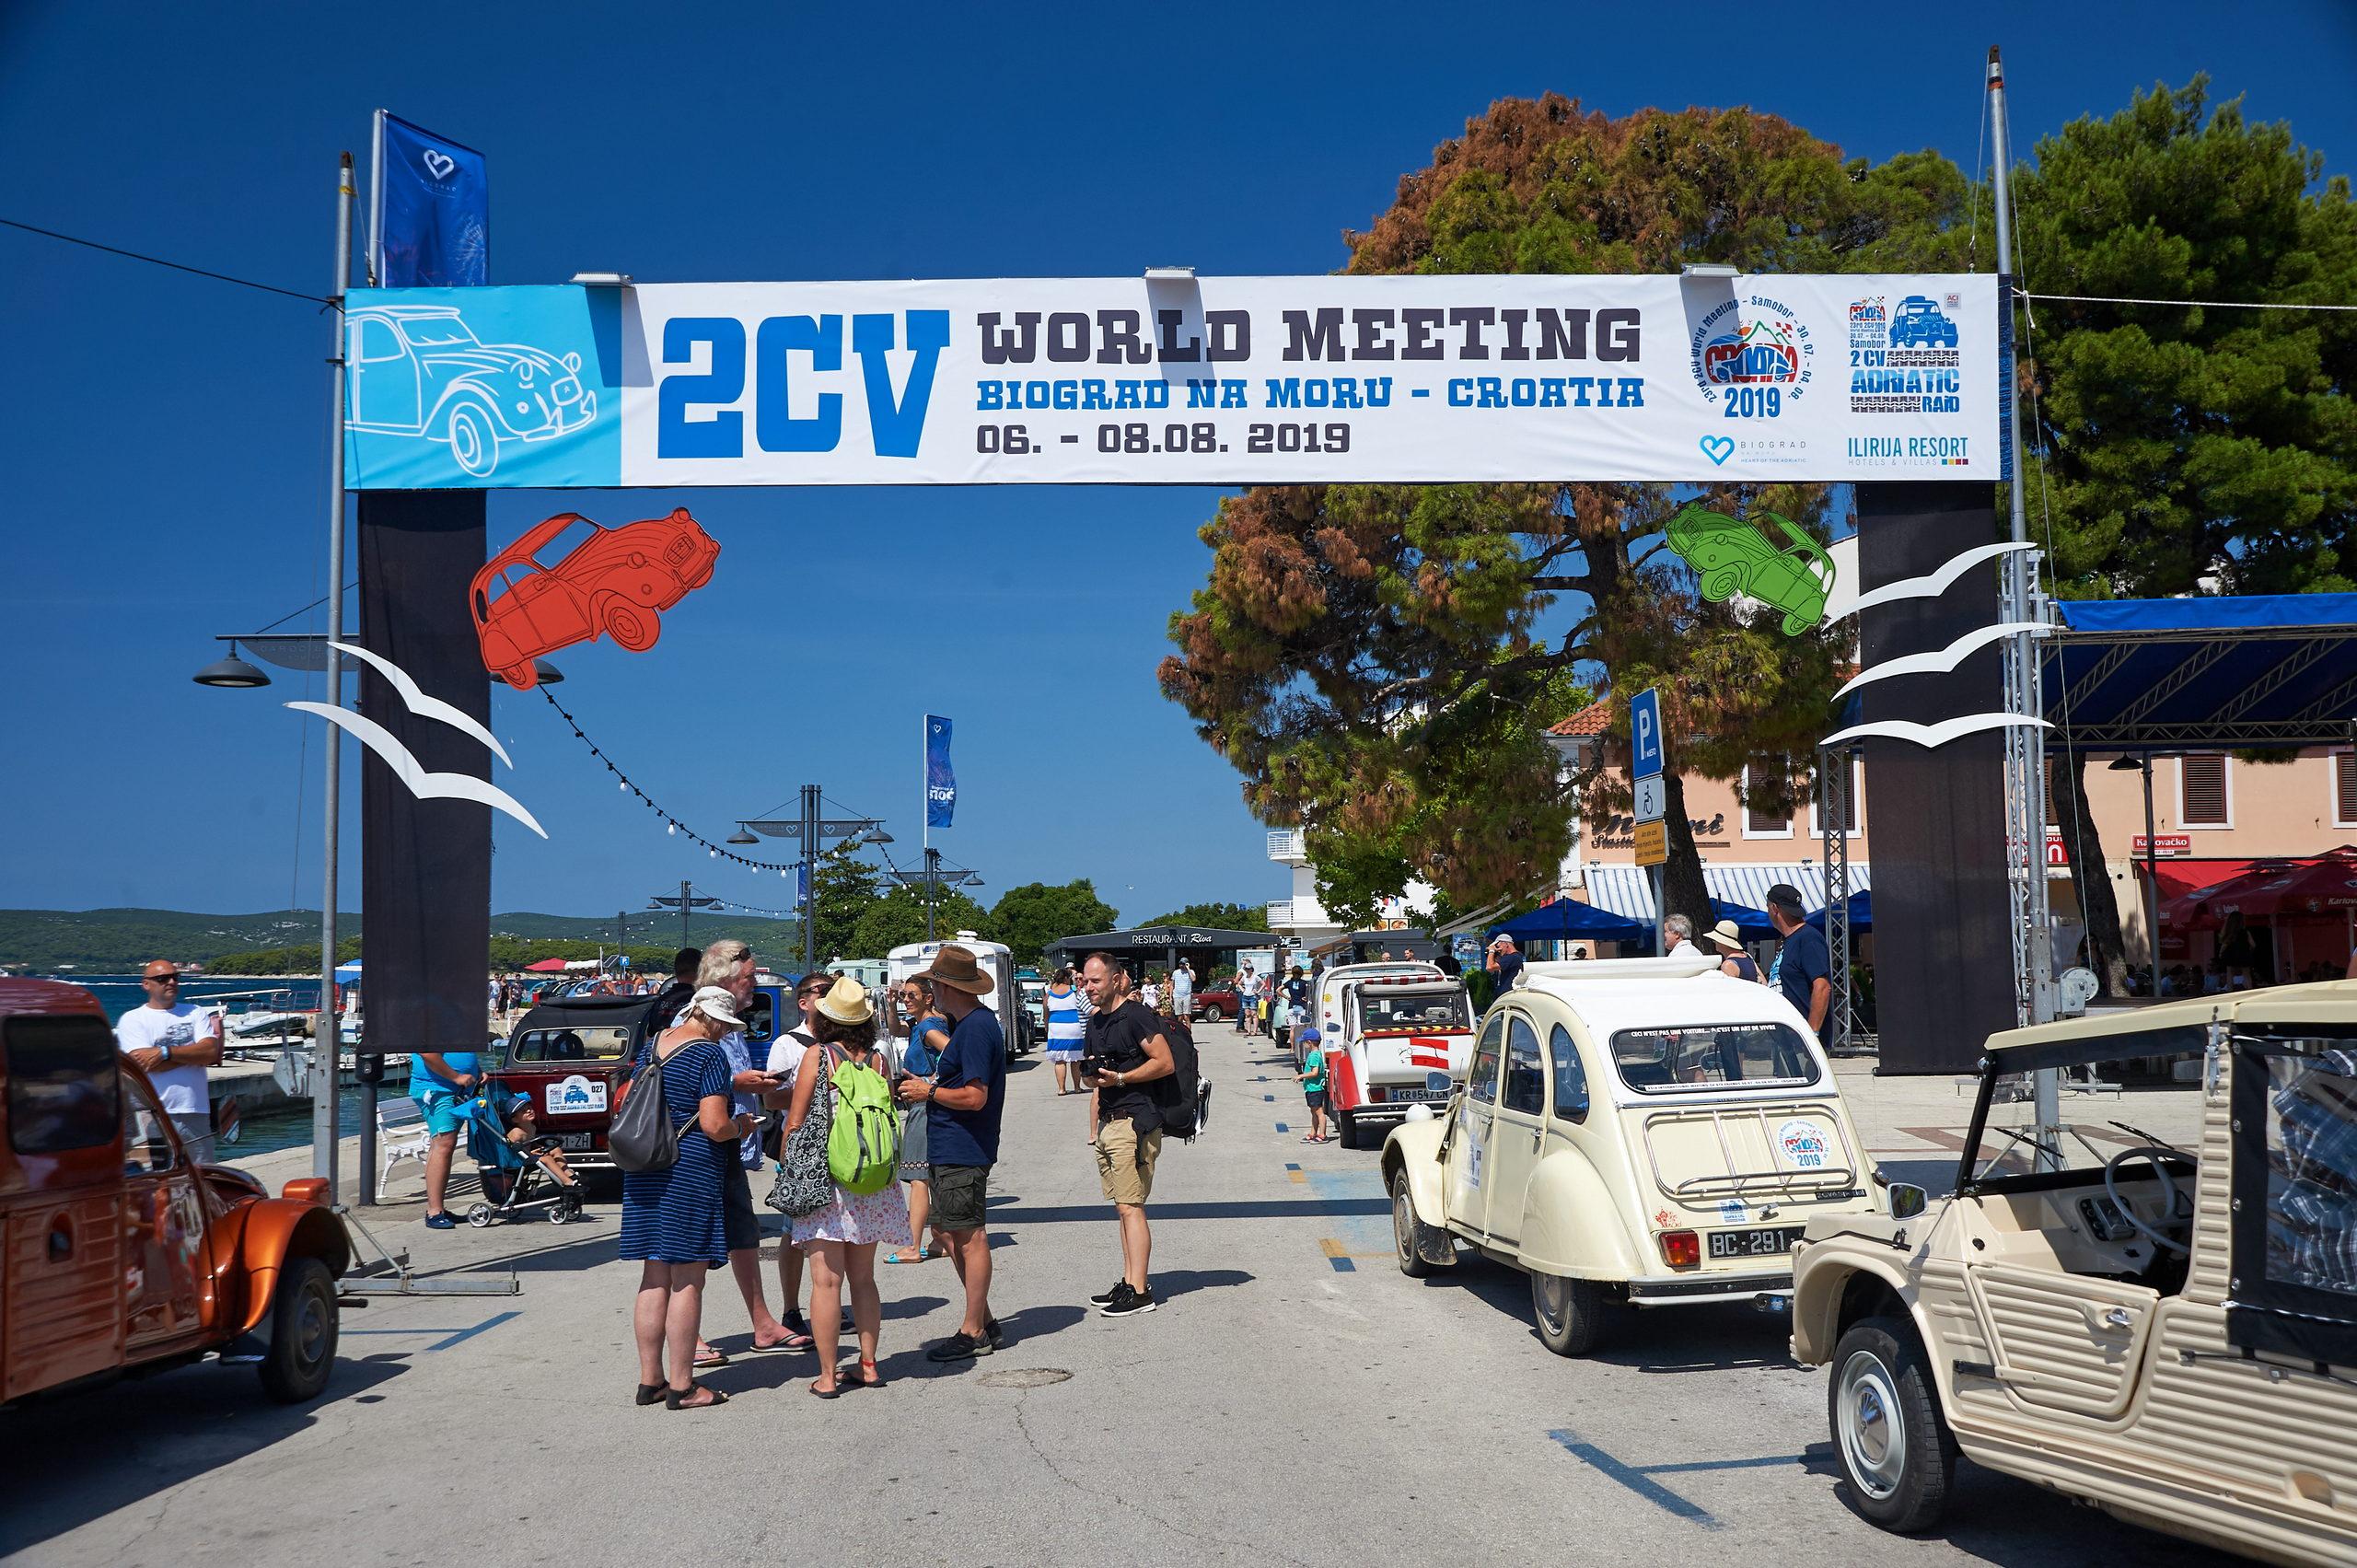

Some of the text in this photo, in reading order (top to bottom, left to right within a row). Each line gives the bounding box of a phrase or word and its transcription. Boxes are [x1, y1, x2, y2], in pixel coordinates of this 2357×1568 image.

[977, 307, 1641, 364] WORLD MEETING
[1690, 327, 1707, 358] World
[1702, 298, 1739, 328] Meeting
[1751, 295, 1794, 319] Samobor
[1850, 339, 1886, 348] Samobor
[1864, 350, 1885, 366] CV
[657, 309, 950, 459] 2CV
[977, 378, 1169, 411] BIOGRAD
[1187, 378, 1248, 409] NA
[1265, 377, 1393, 409] MORU
[1447, 377, 1644, 408] CROATIA
[1724, 387, 1781, 418] 2019
[977, 424, 1041, 454] 06.
[1097, 423, 1229, 453] 08.08.
[1248, 423, 1351, 453] 2019
[1849, 437, 1968, 458] ILIRIJA RESORT
[1639, 708, 1650, 760] P
[2137, 838, 2188, 846] Kaovačko
[1132, 933, 1212, 945] RESTAURANT Riva
[591, 1085, 604, 1093] 027
[1399, 1090, 1411, 1100] KR
[1797, 1154, 1821, 1167] 2019
